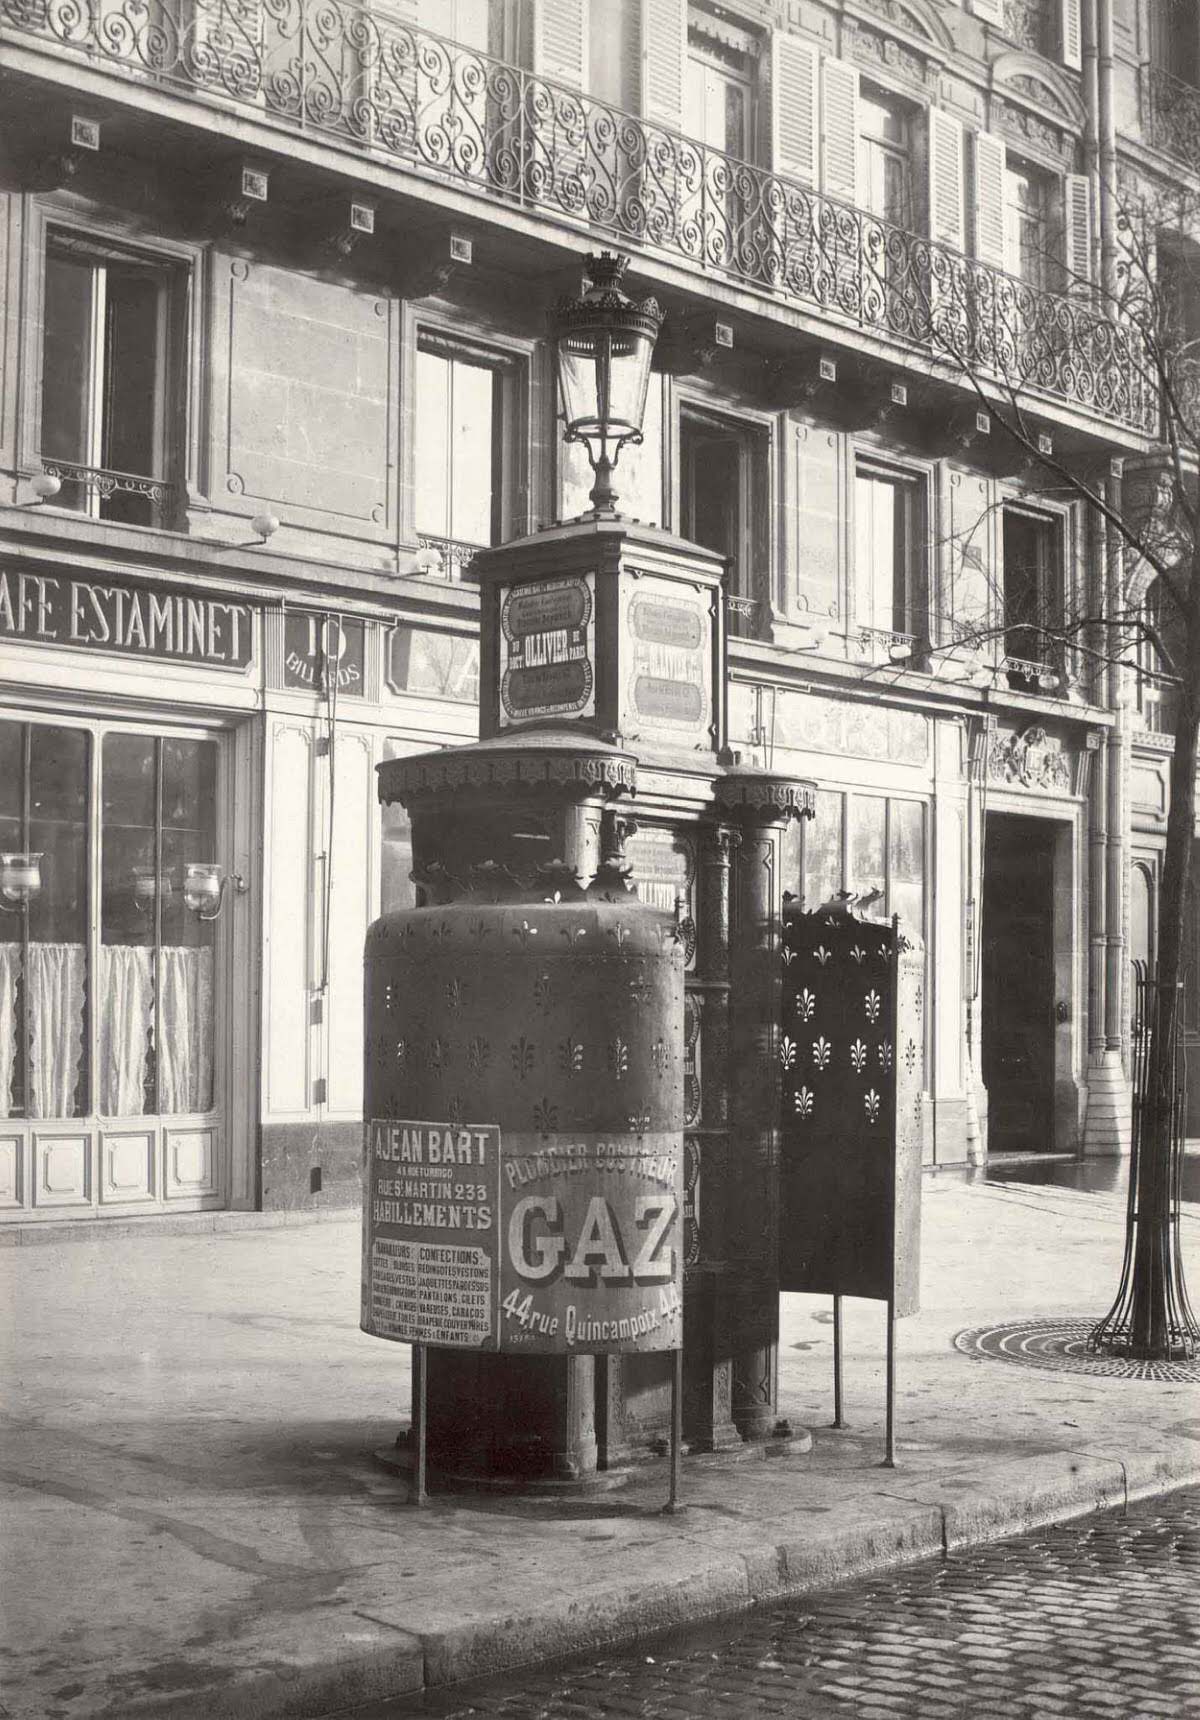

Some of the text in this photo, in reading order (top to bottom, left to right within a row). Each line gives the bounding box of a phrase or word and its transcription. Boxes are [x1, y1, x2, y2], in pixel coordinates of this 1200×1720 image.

[70, 581, 247, 661] ESTAMINET
[307, 615, 347, 660] 10
[383, 1129, 422, 1163] JEAN
[429, 1130, 490, 1165] BART
[372, 1199, 492, 1229] HABILLEMENTS
[455, 1184, 487, 1201] 233
[508, 1195, 678, 1282] GAZ
[531, 1311, 558, 1337] rue
[565, 1302, 661, 1346] Quincampoix
